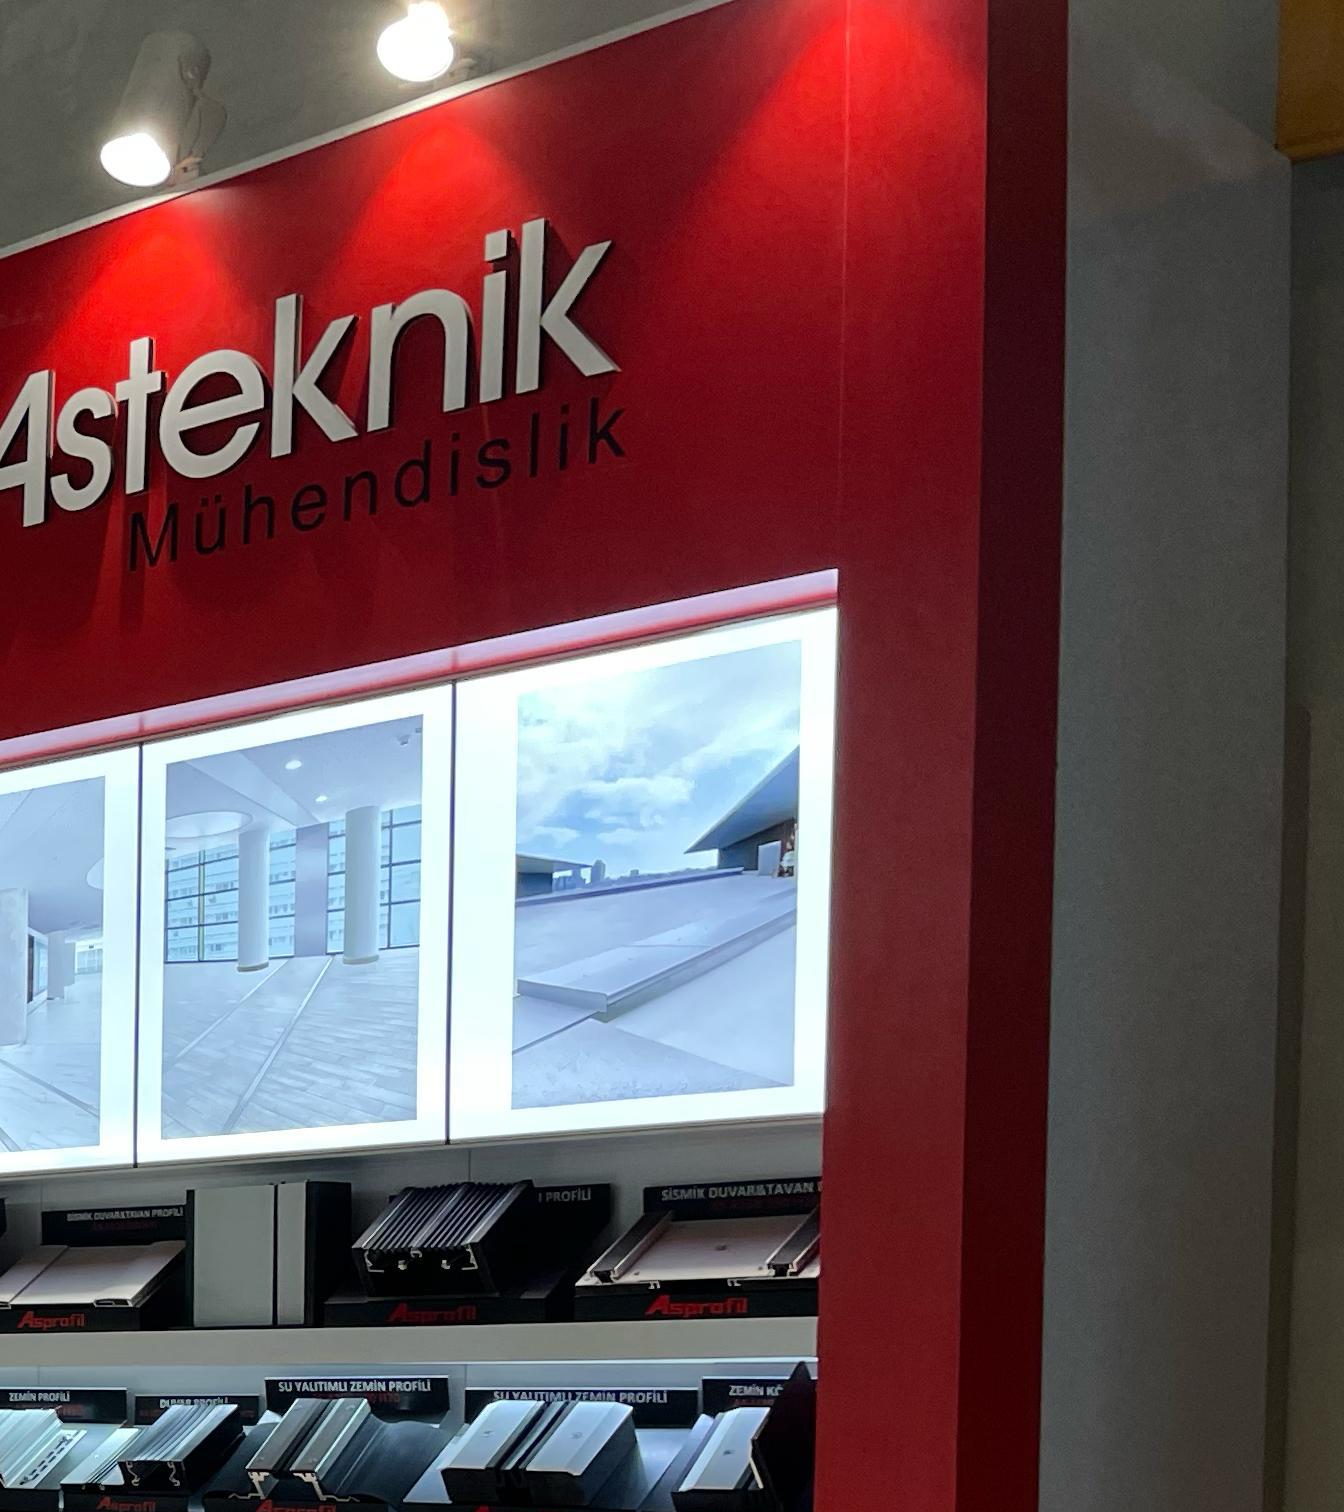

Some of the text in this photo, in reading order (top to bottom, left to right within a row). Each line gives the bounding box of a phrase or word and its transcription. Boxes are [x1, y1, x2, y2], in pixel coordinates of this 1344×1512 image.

[125, 399, 628, 572] Mühendislik
[545, 1186, 592, 1203] PROFİLİ
[661, 1185, 705, 1202] SİSMİK
[386, 1302, 477, 1323] Asprofil
[645, 1293, 748, 1319] Asprofil
[17, 1310, 85, 1330] Asprofil
[278, 1378, 432, 1392] SU YALITIMLI ZEMİN PROFİLİ
[728, 1383, 765, 1397] ZEMİN
[8, 1390, 71, 1403] ZEMİN PROFİLİ
[574, 1390, 617, 1403] ZEMİN
[618, 1390, 668, 1403] PROFİLİ
